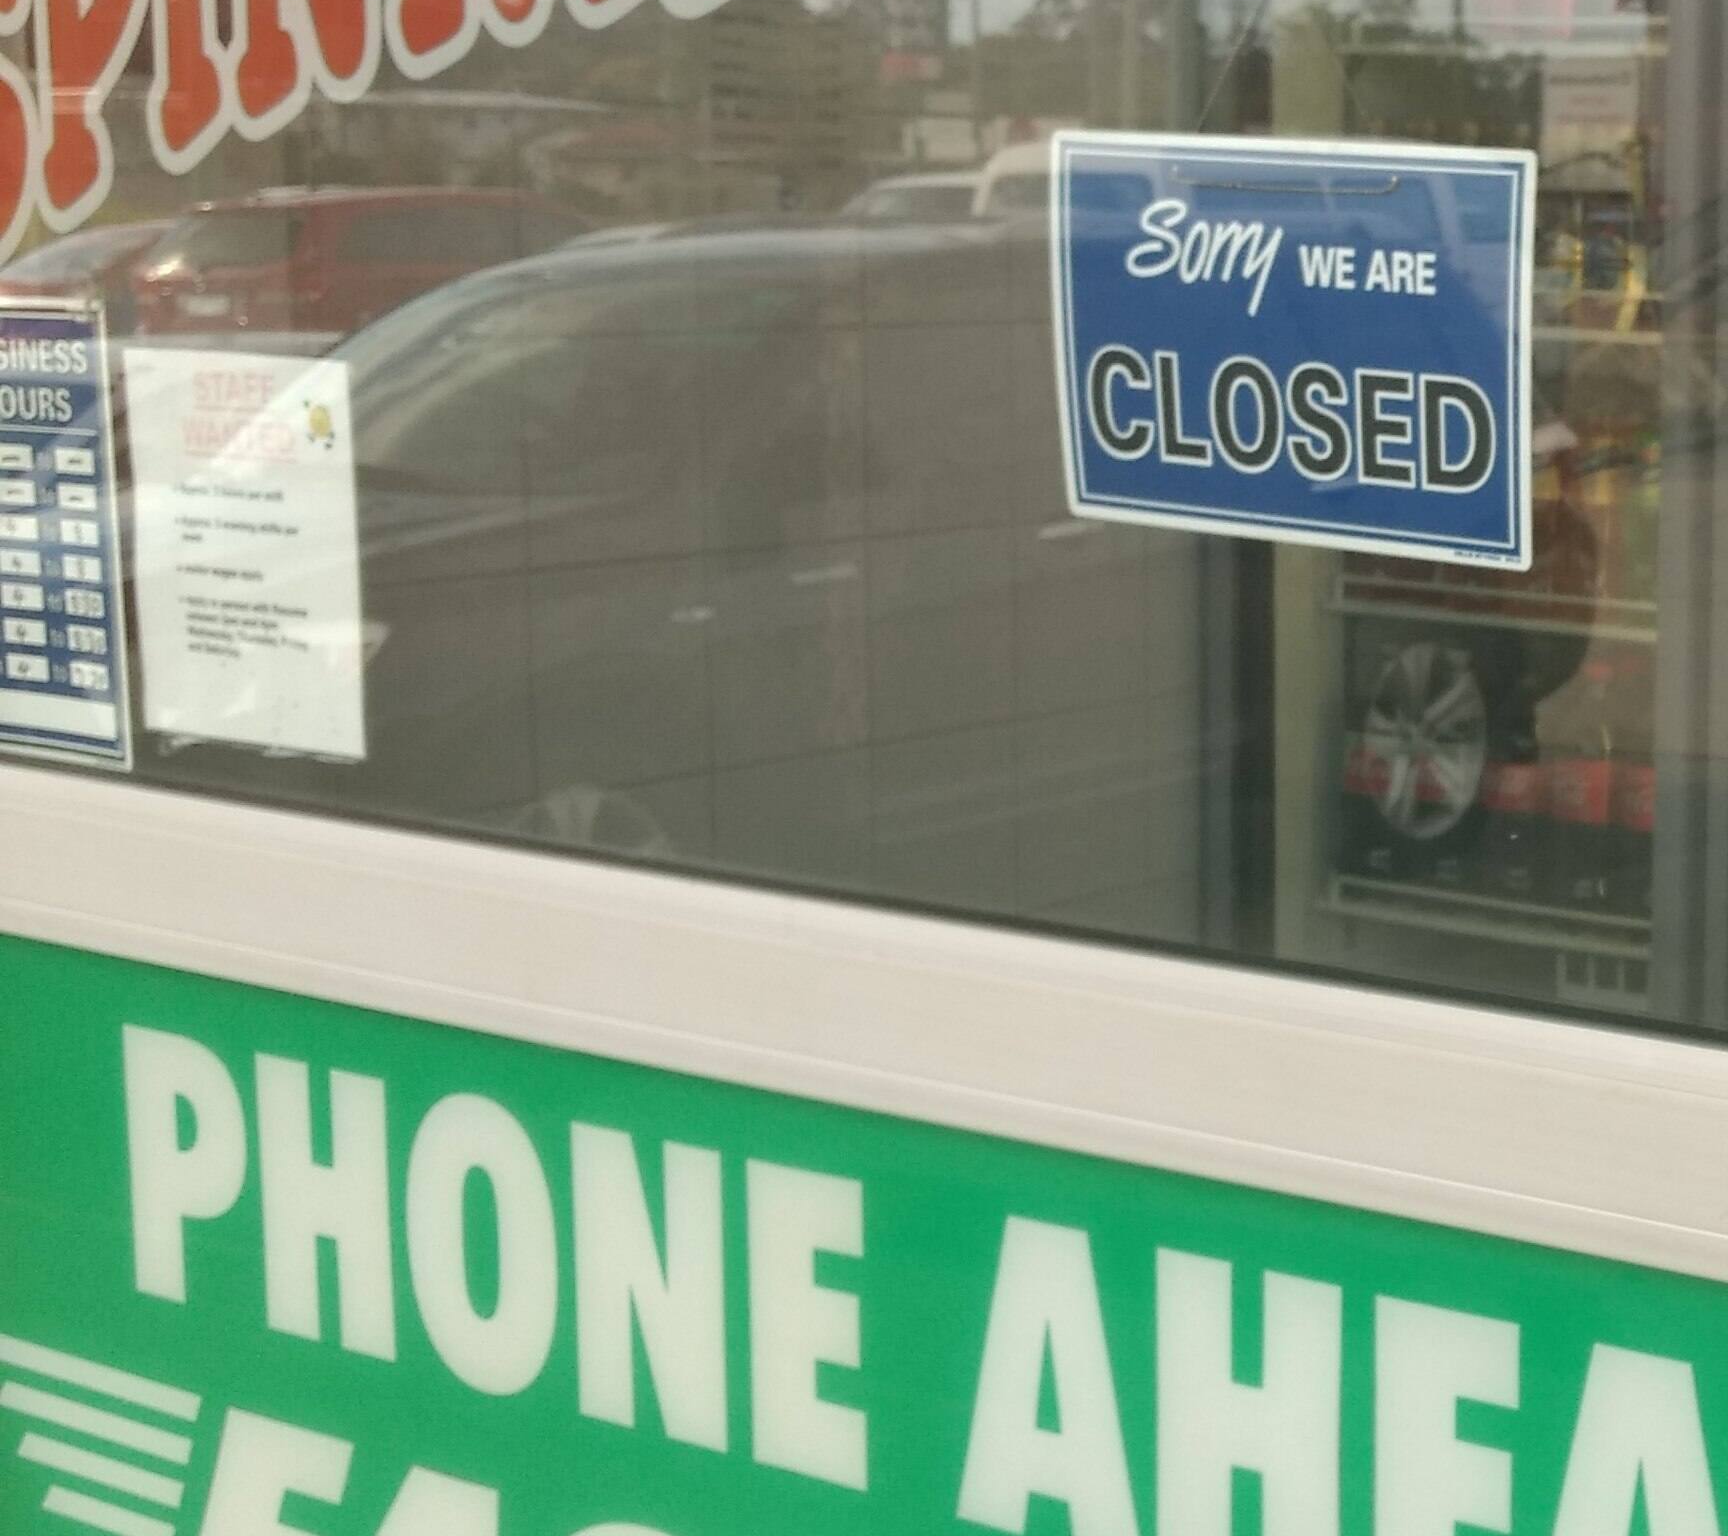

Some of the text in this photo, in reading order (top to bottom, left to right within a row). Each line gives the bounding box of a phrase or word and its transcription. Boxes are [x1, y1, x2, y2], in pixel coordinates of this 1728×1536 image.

[1125, 198, 1437, 317] Sorry WE ARE
[0, 383, 73, 423] OURS
[1087, 343, 1497, 494] CLOSED
[122, 1020, 869, 1494] PHONE
